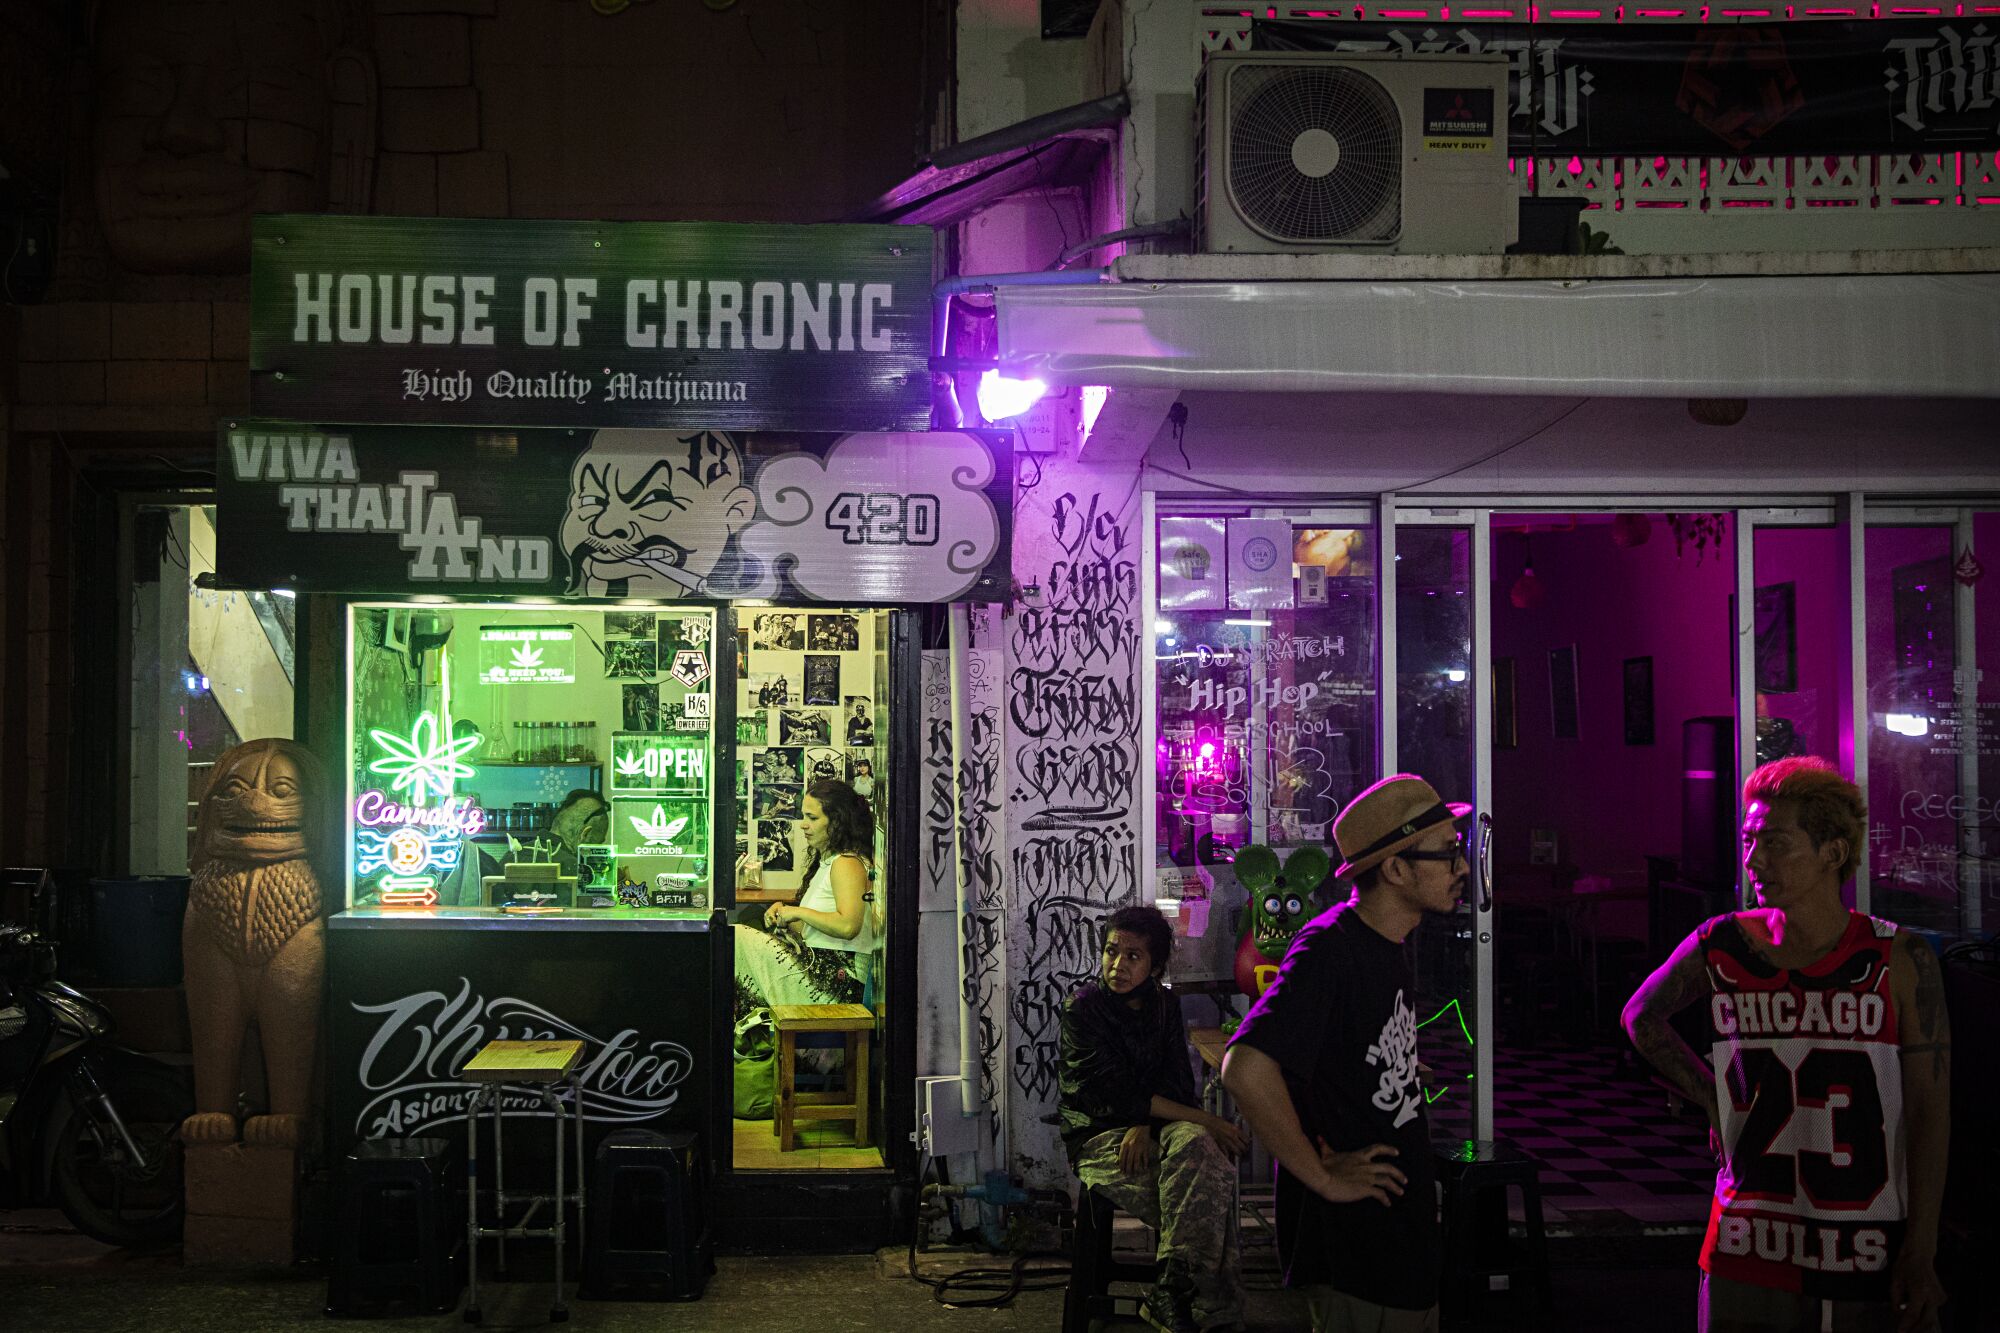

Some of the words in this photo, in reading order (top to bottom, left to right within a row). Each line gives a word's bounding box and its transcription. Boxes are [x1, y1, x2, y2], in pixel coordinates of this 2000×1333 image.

[1429, 121, 1488, 129] MITSUBISHI
[293, 273, 496, 346] HOUSE
[523, 277, 598, 349] OF
[626, 279, 893, 353] CHRONIC
[401, 367, 473, 402] High
[486, 369, 592, 404] Quality
[231, 435, 356, 480] VIVA
[825, 493, 940, 546] 420
[644, 748, 704, 778] OPEN
[356, 790, 486, 835] Cannabis
[635, 846, 683, 855] cannabis
[1712, 991, 1885, 1037] CHICAGO
[366, 1092, 464, 1140] Asian
[1725, 1047, 1889, 1212] 23
[1718, 1214, 1888, 1272] BULLS
